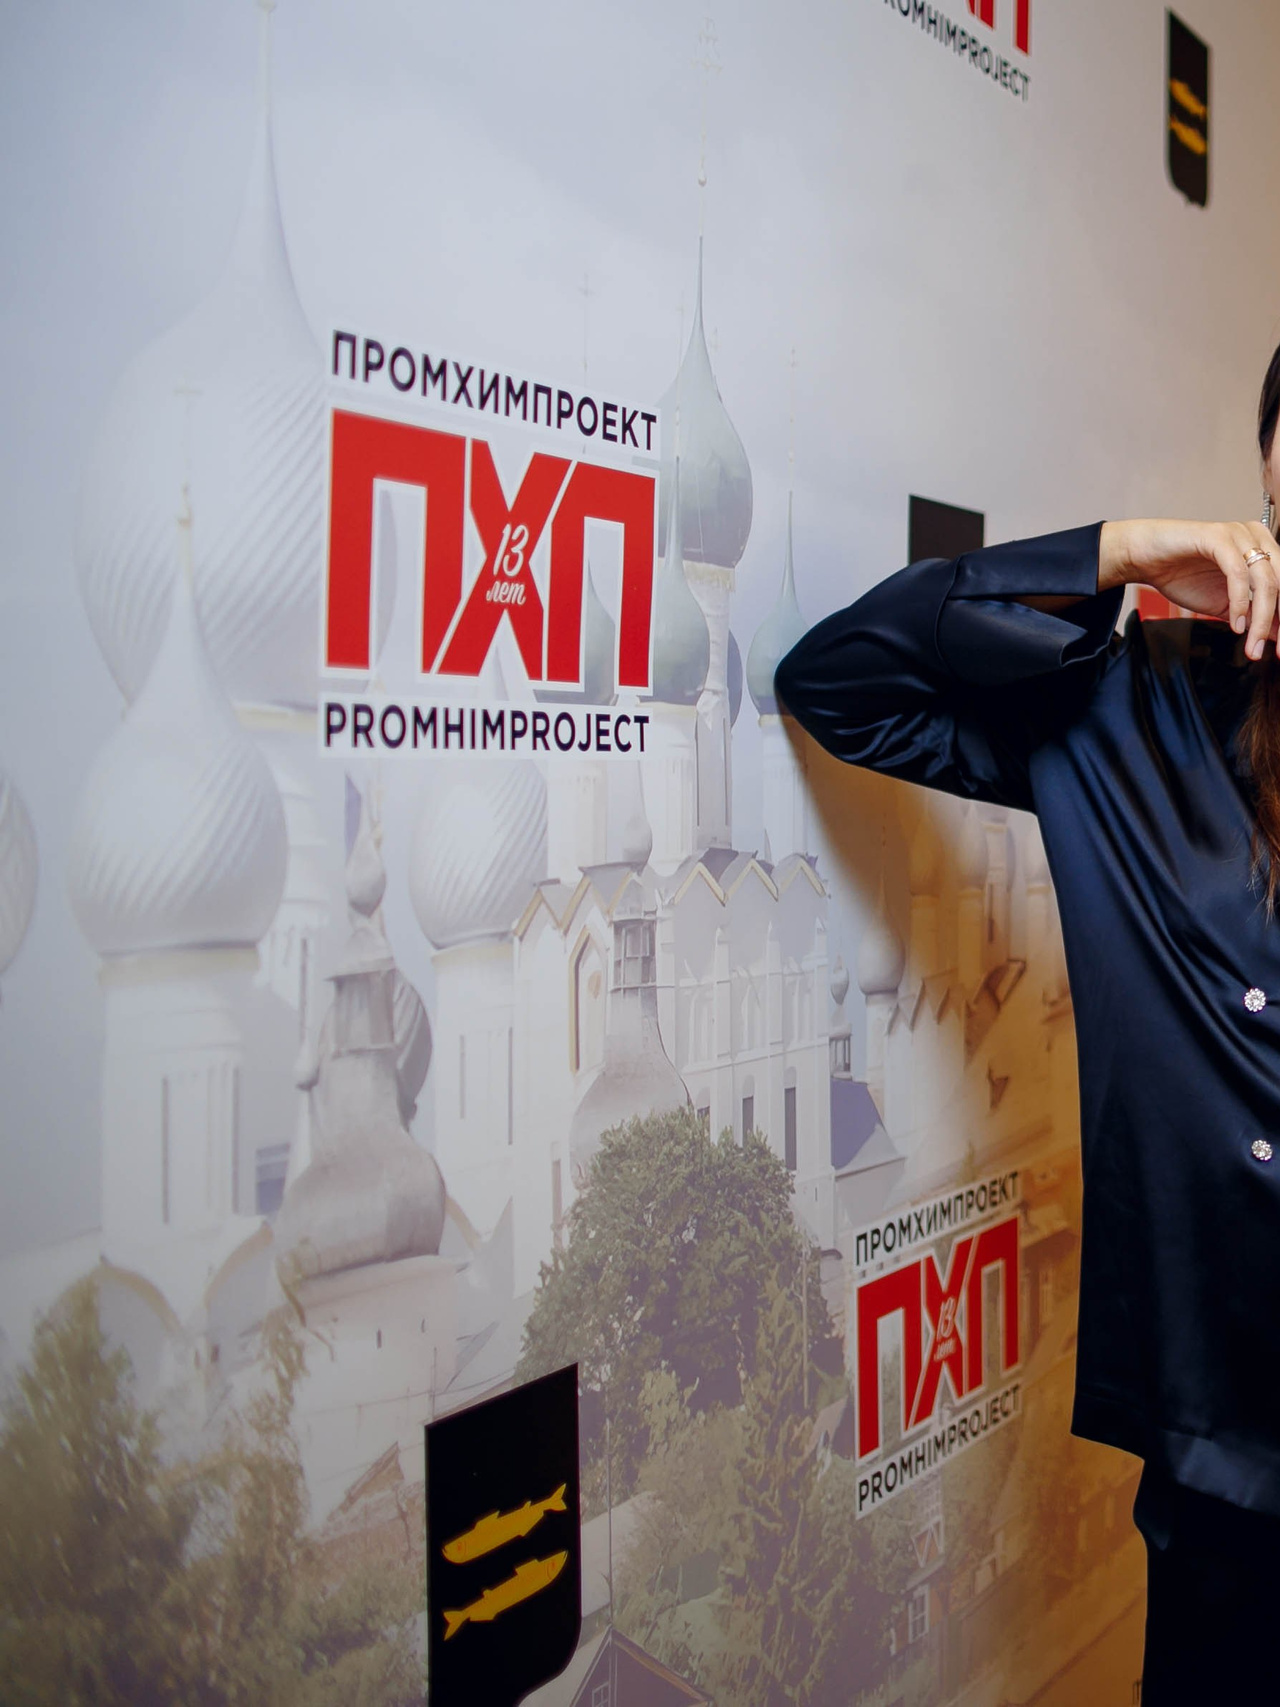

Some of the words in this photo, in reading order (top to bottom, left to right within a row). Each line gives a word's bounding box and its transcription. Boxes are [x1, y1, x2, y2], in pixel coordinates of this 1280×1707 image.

[332, 329, 657, 451] ПРОМХИМПРОЕКТ
[325, 407, 656, 688] ПХП
[486, 580, 527, 606] лет
[493, 523, 530, 577] 13
[325, 701, 650, 753] PROMHIMPROJECT
[856, 1171, 1019, 1267] ПРОМХИМПРОЕКТ
[857, 1216, 1019, 1460] ПХП
[858, 1385, 1020, 1512] PROMHIMPROJECT
